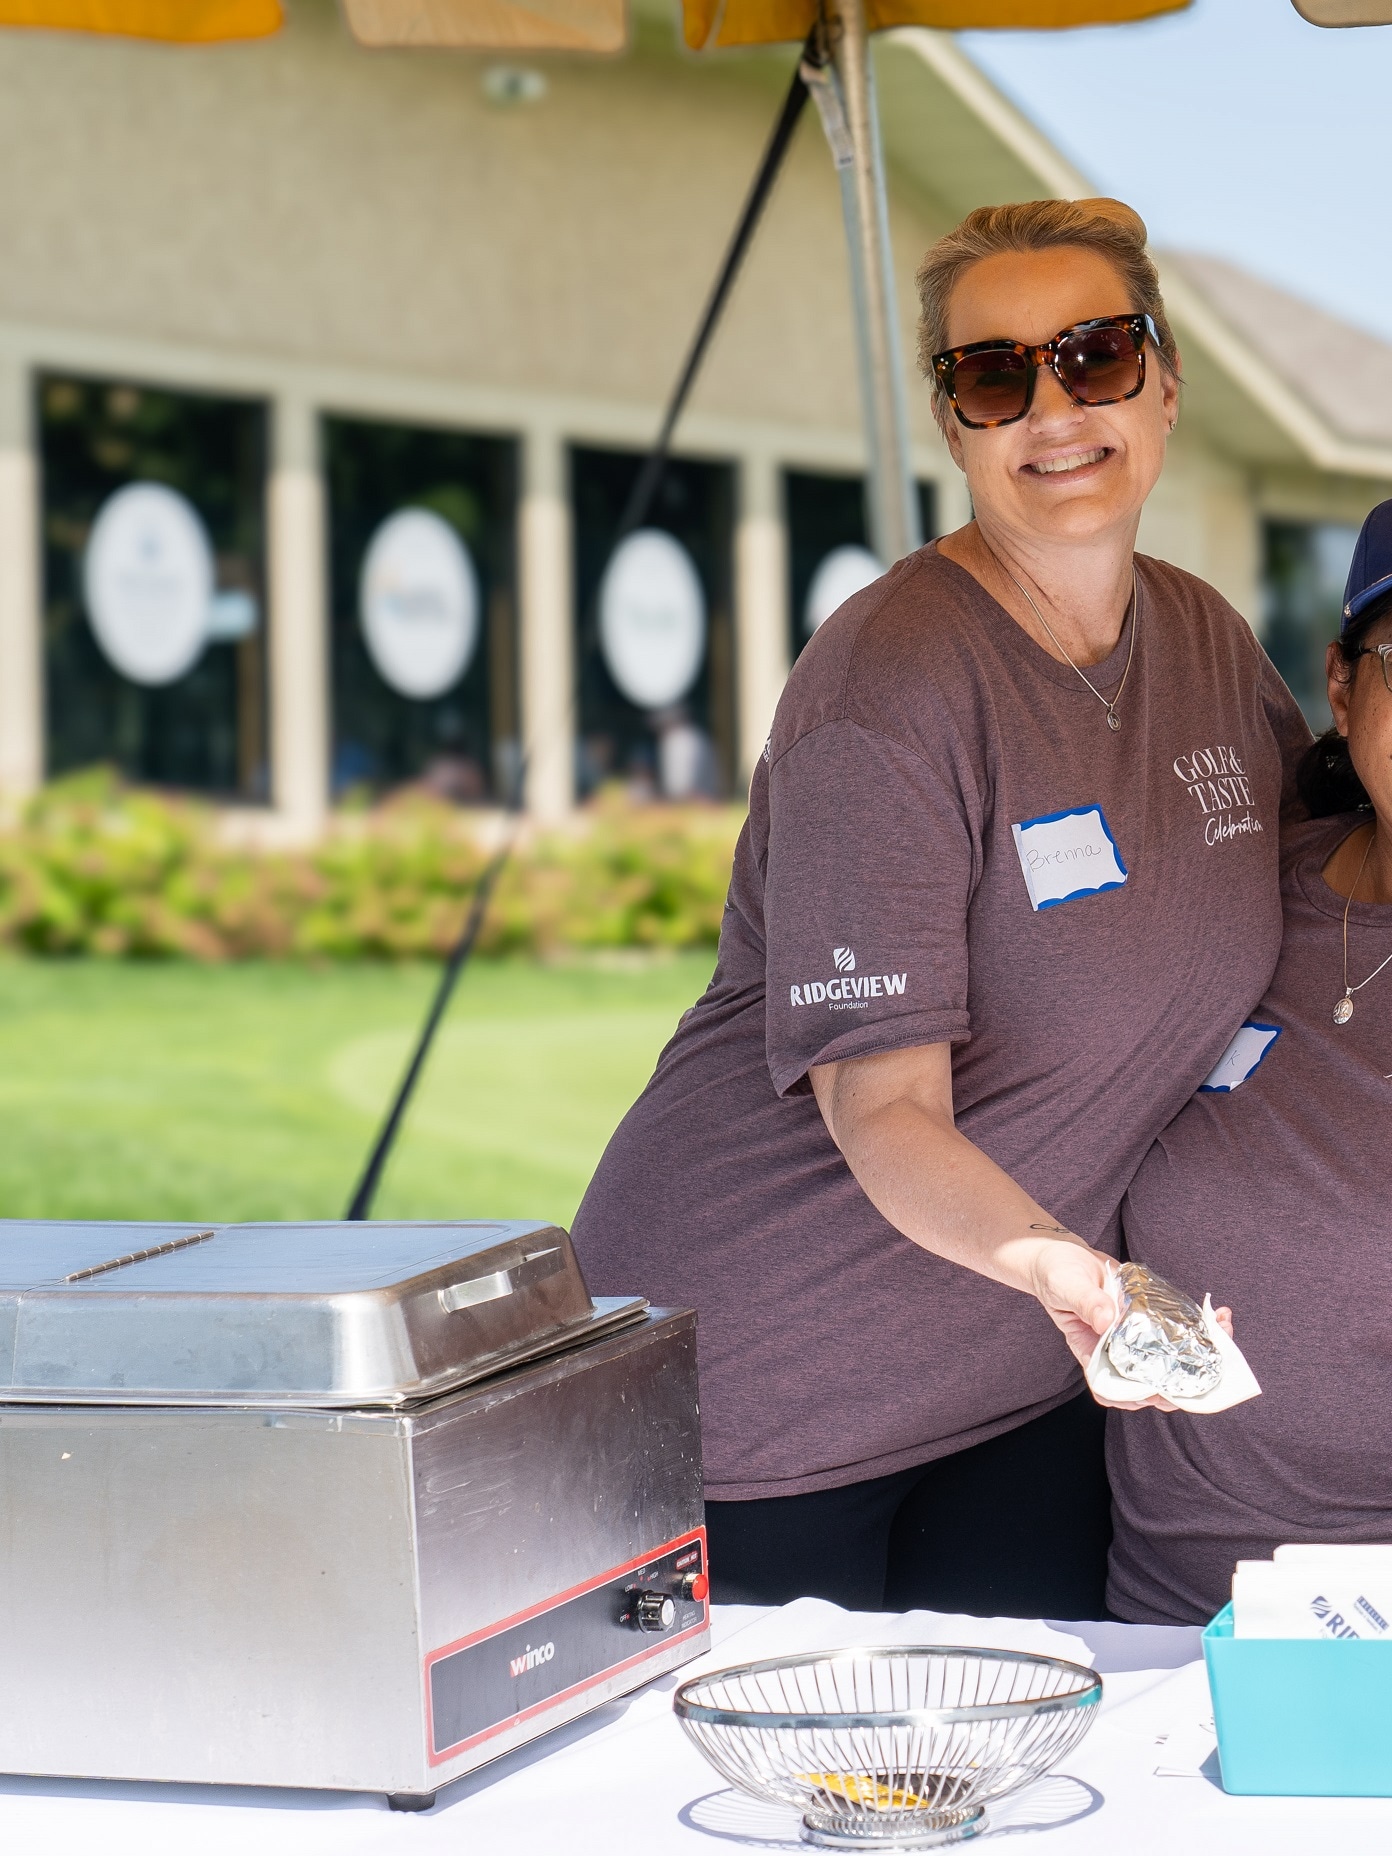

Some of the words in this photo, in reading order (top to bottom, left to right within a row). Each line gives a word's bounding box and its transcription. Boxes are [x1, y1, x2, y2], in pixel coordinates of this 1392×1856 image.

[1173, 746, 1246, 783] GOLF&
[1188, 776, 1255, 815] TASTE
[1024, 843, 1102, 873] Brenna
[790, 973, 908, 1007] RIDGEVIEW
[828, 1000, 869, 1011] Foundation
[509, 1641, 555, 1678] winco
